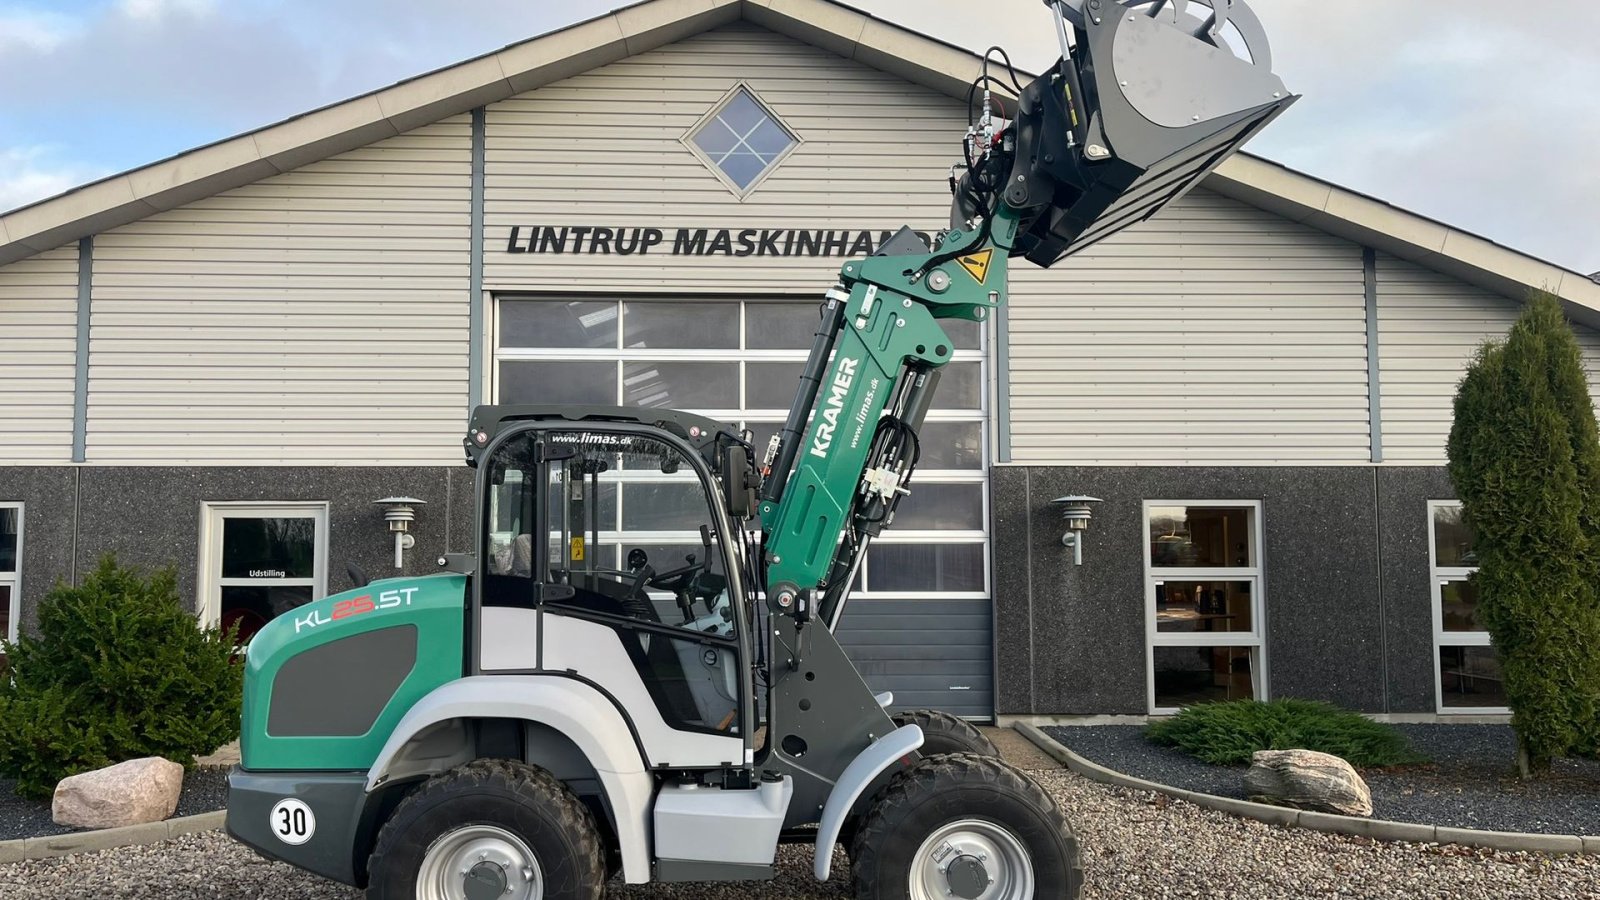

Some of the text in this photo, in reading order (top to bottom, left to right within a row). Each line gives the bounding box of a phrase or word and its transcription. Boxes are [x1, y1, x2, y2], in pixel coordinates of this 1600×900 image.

[507, 226, 663, 255] LINTRUP
[810, 357, 858, 458] KRAMER
[851, 377, 879, 449] www.limas.dk
[552, 432, 632, 445] www.limas.dk
[249, 569, 286, 579] Udstilling
[294, 587, 419, 634] KL25.5T
[278, 807, 306, 837] 30
